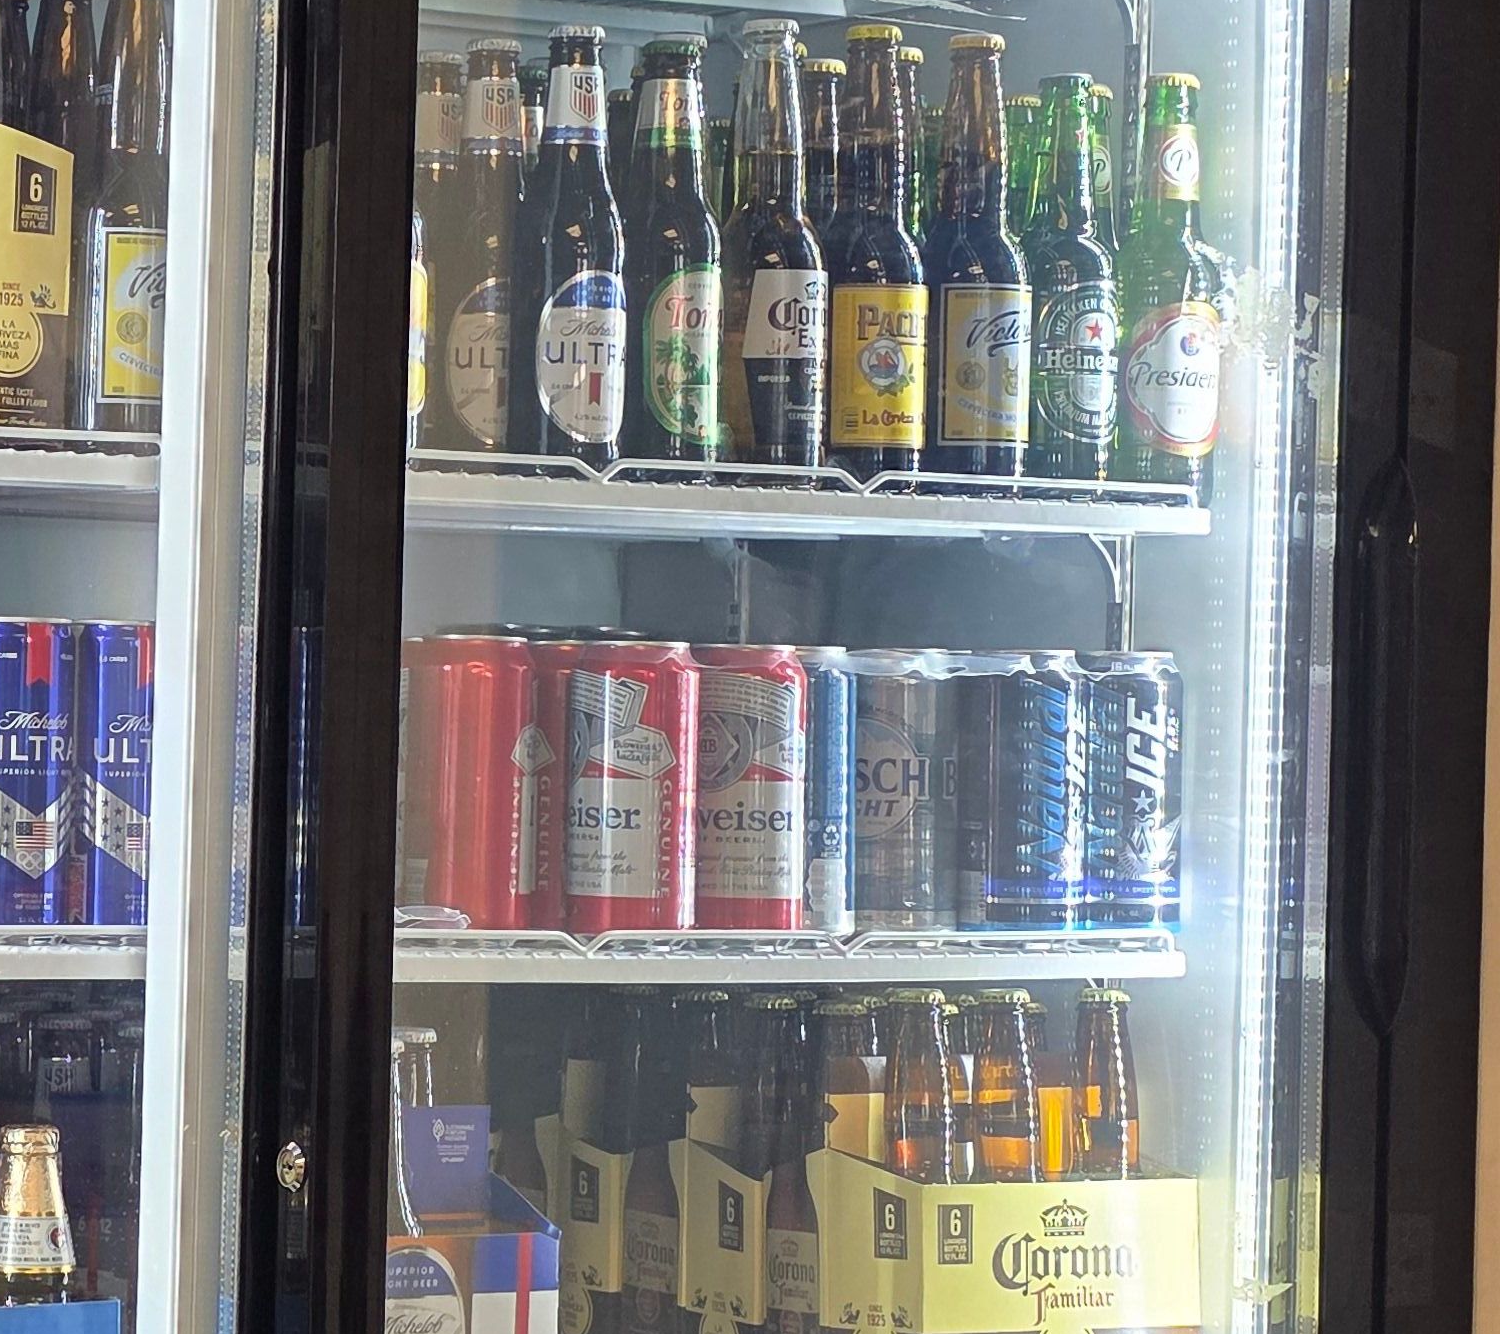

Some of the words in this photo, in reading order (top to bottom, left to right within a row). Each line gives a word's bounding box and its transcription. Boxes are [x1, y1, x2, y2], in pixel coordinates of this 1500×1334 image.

[29, 172, 44, 203] 6
[1, 318, 16, 329] LA
[1126, 695, 1167, 791] ICE
[578, 1170, 588, 1196] 6
[726, 1197, 736, 1223] 6
[884, 1202, 897, 1231] 6
[950, 1208, 964, 1236] 6
[387, 1266, 436, 1278] UPERIOR
[991, 1231, 1135, 1295] Corona
[1030, 1281, 1116, 1327] Familiar
